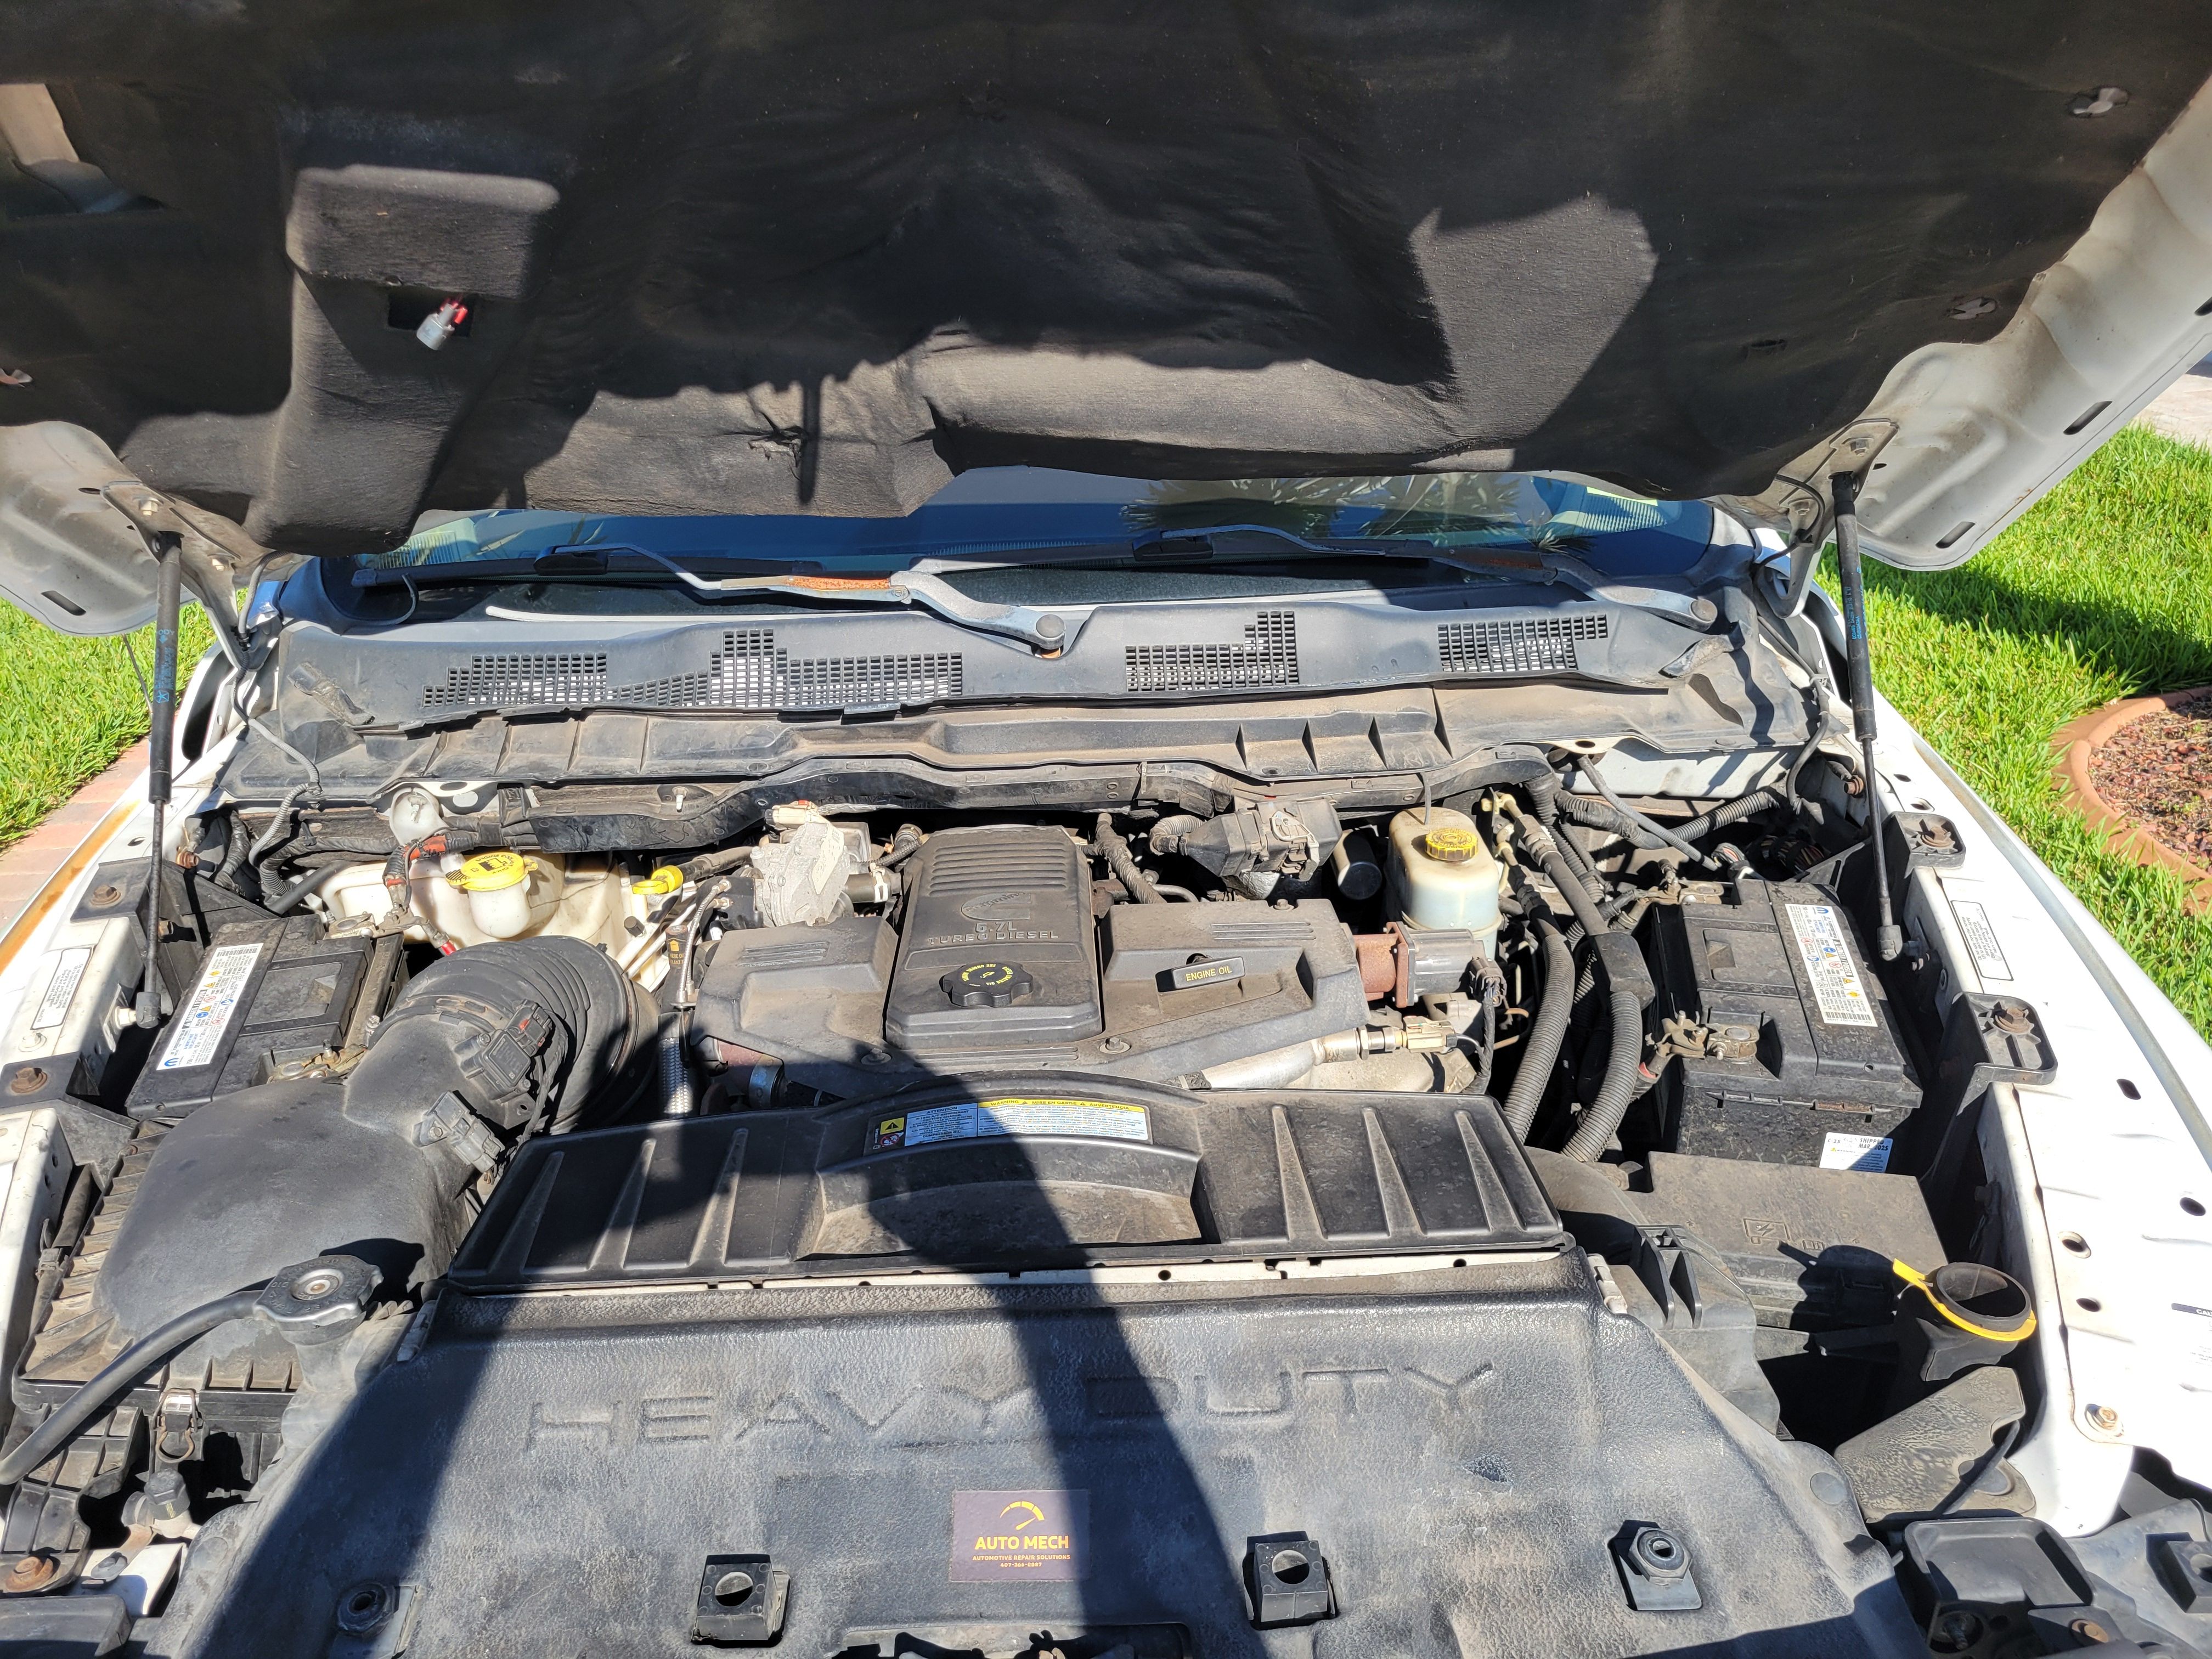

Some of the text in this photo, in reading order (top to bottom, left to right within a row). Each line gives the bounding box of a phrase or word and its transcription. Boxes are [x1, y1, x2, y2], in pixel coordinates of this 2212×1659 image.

[975, 922, 1017, 933] 6.7L
[928, 931, 1059, 945] TURBO DIESEL
[1186, 966, 1232, 981] ENGINE OIL
[527, 1362, 1493, 1454] HEAVY DUTY
[974, 1535, 1069, 1550] AUTO MECH
